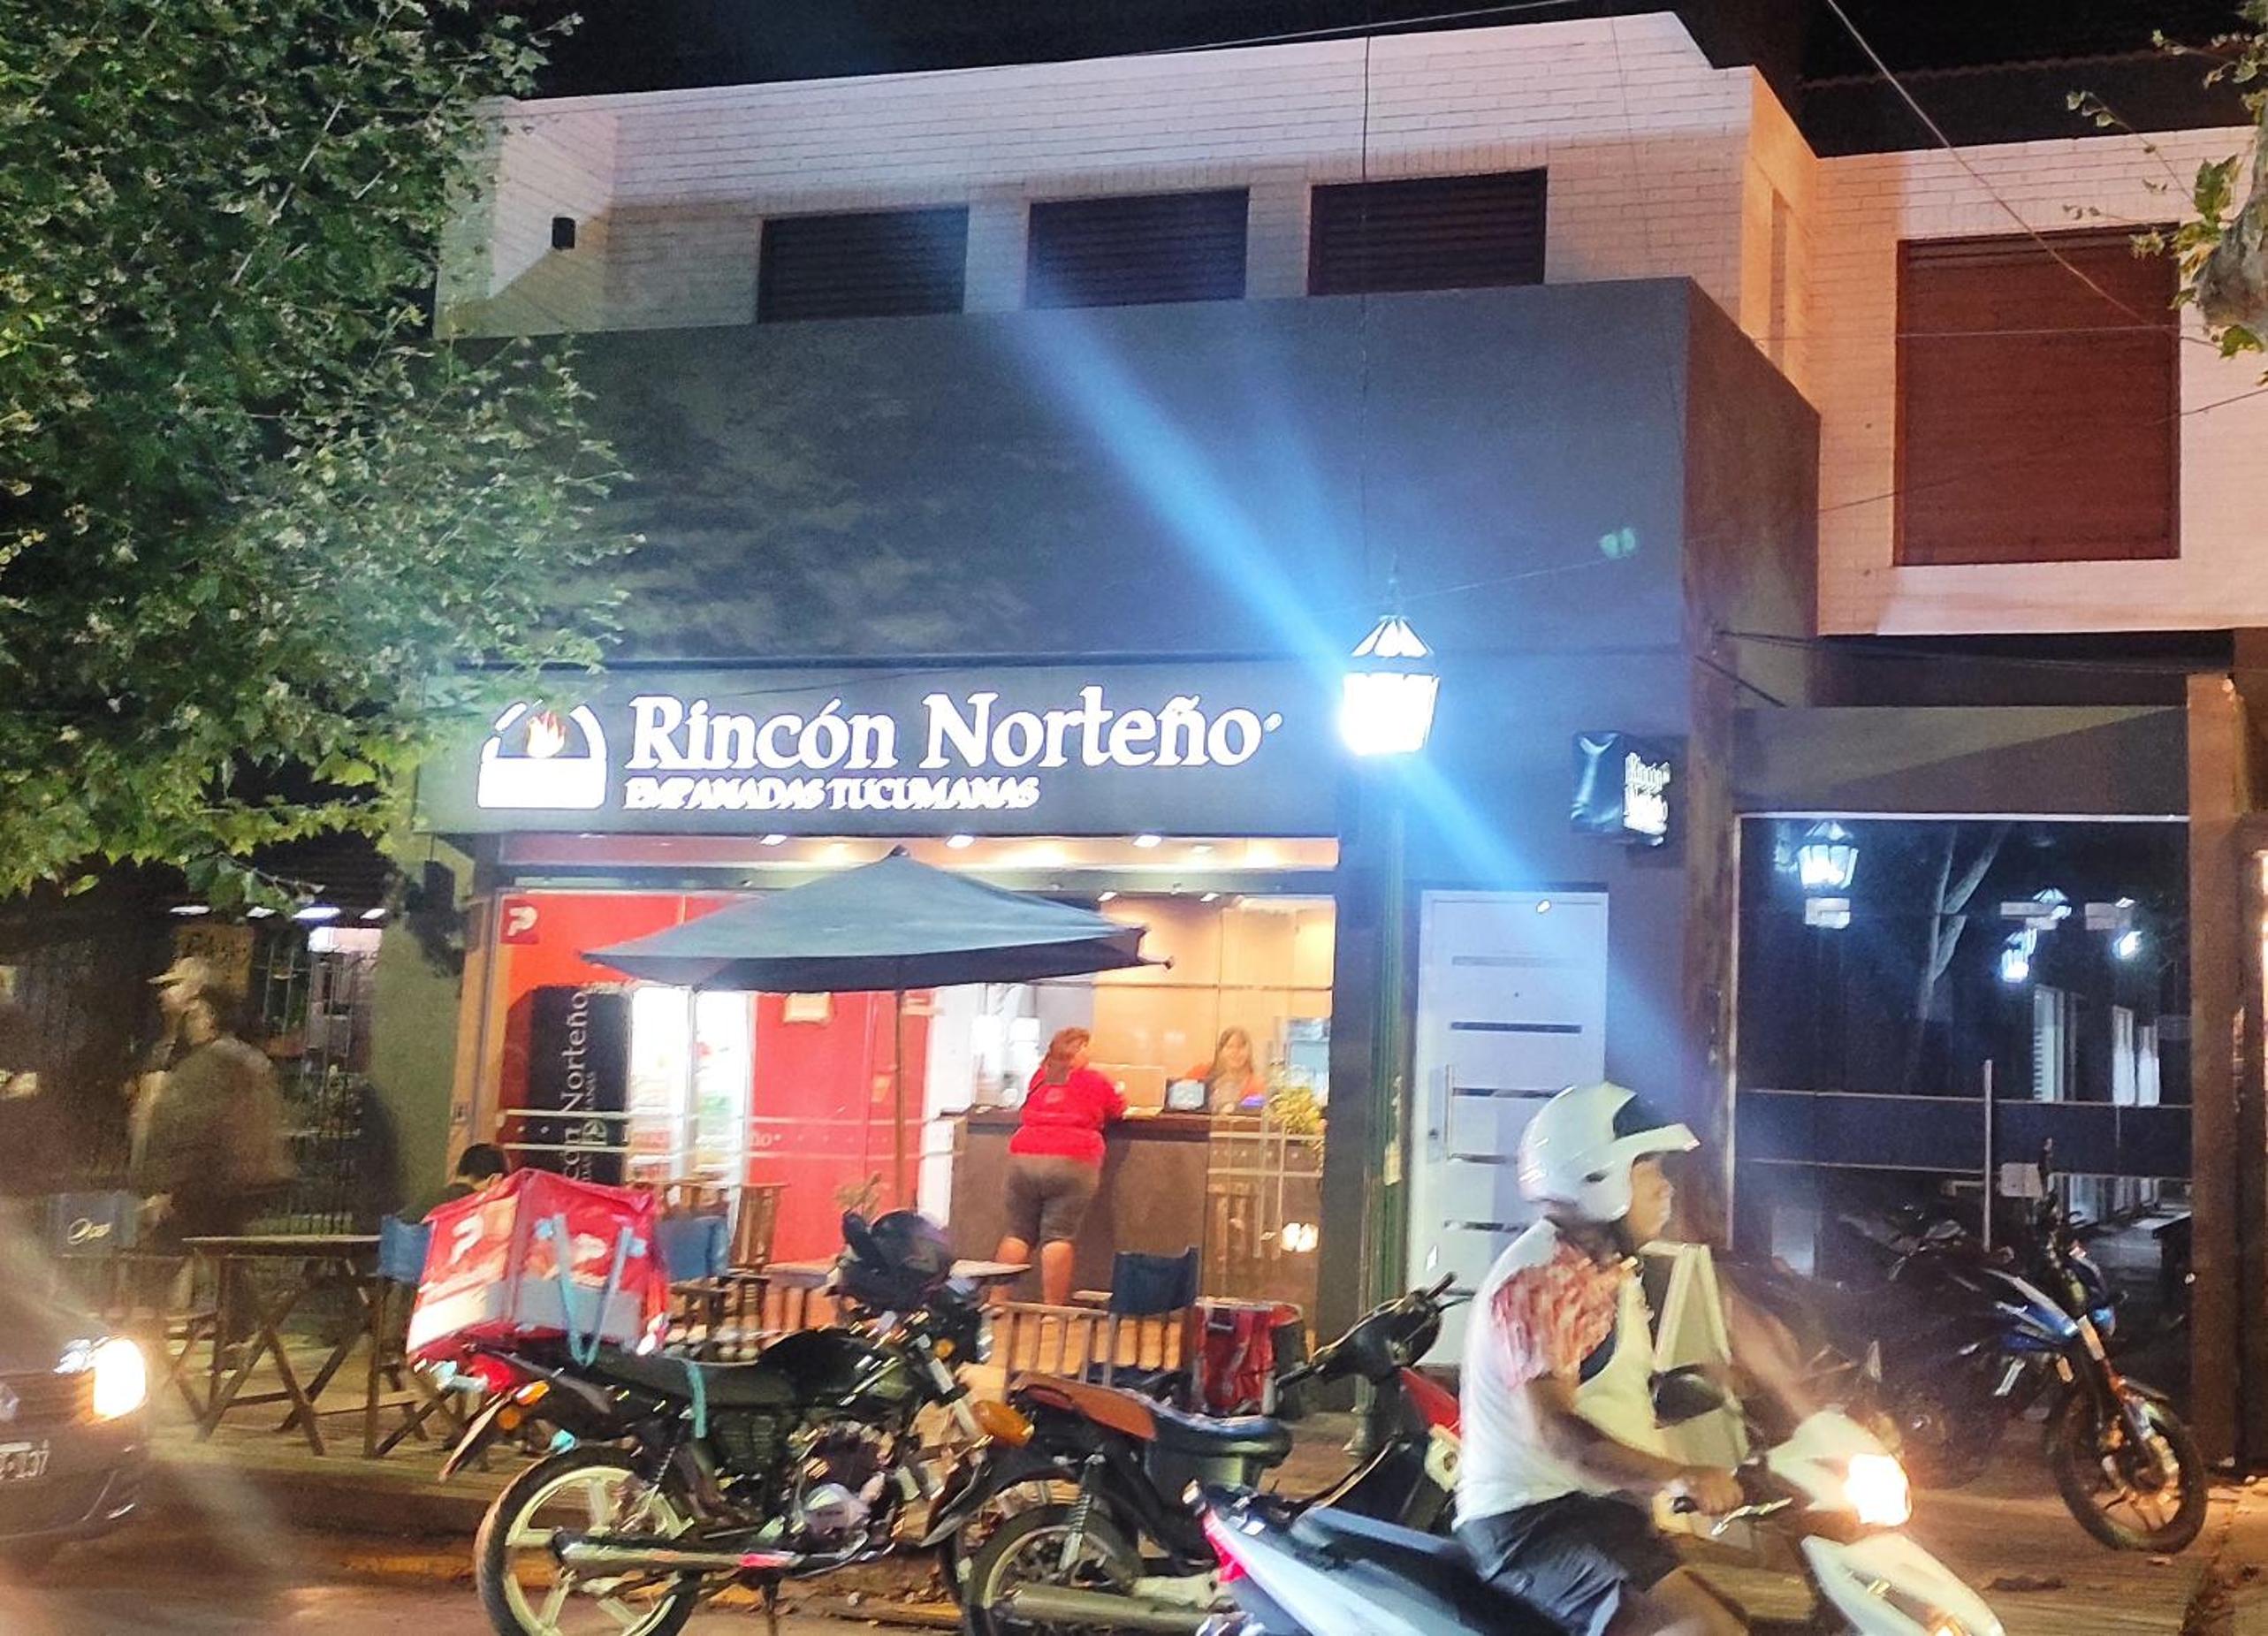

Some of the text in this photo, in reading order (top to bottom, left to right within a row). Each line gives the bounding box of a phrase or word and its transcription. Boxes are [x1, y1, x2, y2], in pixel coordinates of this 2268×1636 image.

[625, 685, 1262, 770] Rincón Norteño
[623, 776, 1040, 810] EMPANADAS TUCUMANAS
